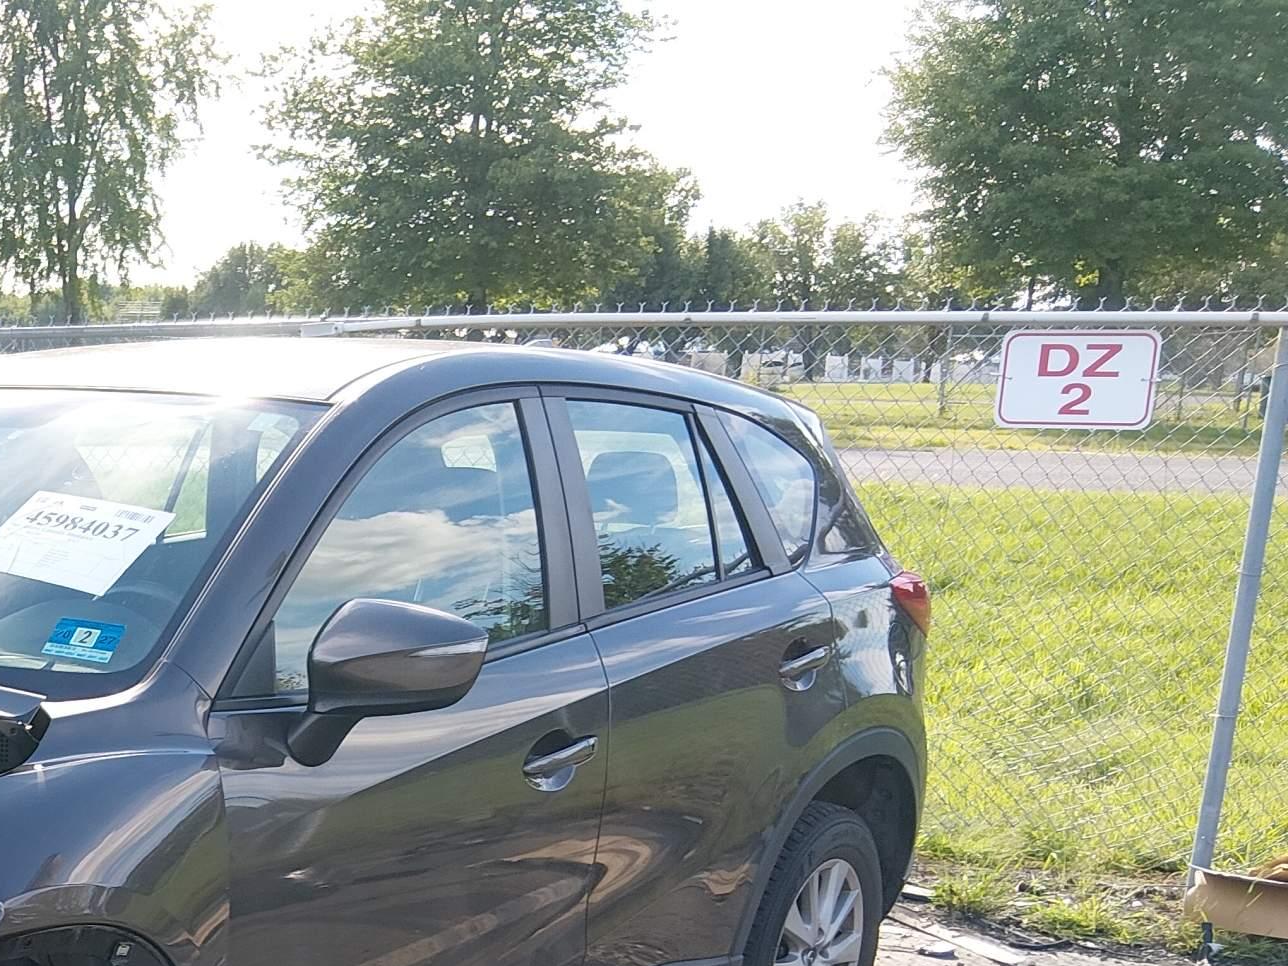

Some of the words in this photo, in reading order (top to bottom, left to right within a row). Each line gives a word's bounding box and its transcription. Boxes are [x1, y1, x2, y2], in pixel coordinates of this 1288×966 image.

[1038, 343, 1123, 378] DZ
[1057, 383, 1092, 415] 2
[26, 510, 140, 541] 45984037
[78, 630, 92, 644] 2
